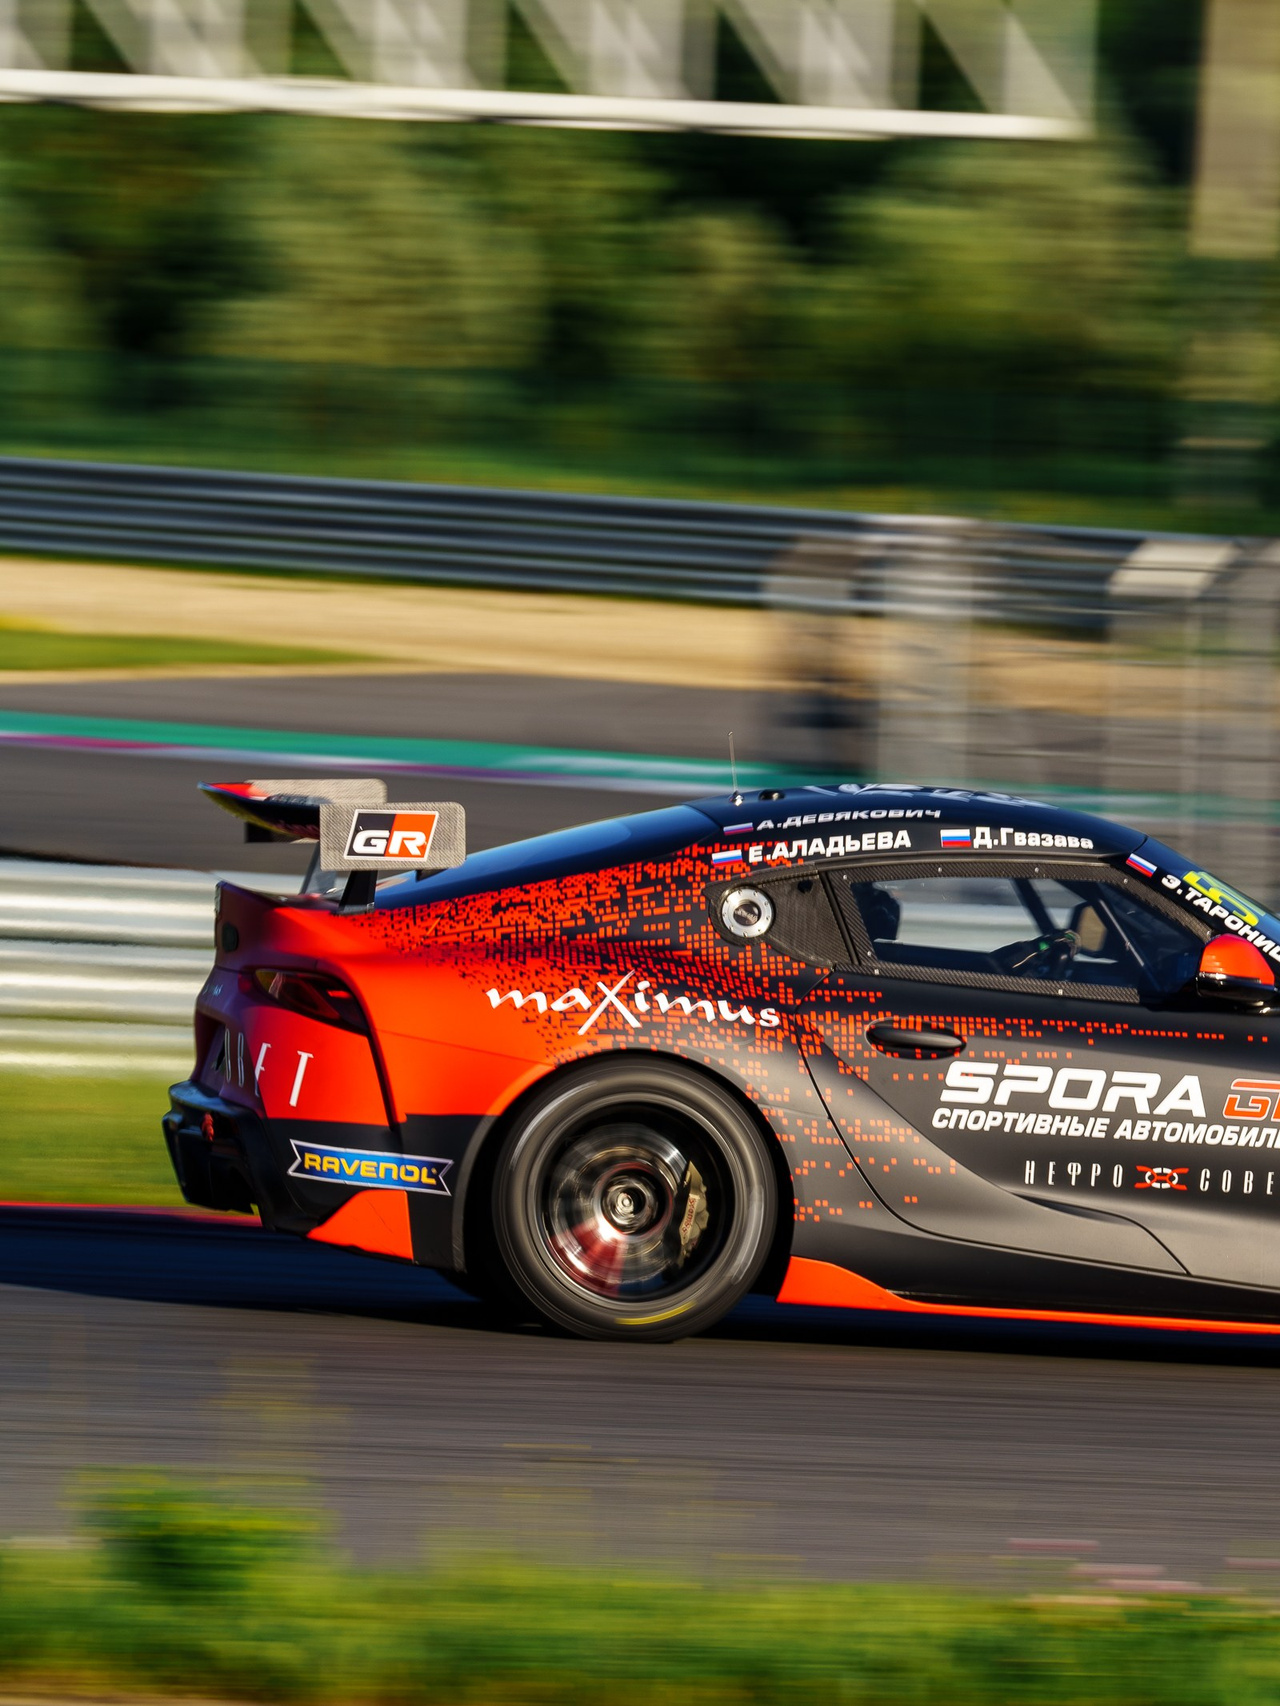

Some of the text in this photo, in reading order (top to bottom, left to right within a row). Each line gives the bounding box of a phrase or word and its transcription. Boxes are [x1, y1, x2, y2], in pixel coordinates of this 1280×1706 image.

[756, 808, 942, 831] А.ДЕВЯКОВИЧ
[352, 829, 428, 856] GR
[747, 829, 912, 864] Е.АЛАДЬЕВА
[973, 826, 1095, 850] Д.Гвазава
[939, 1060, 1207, 1119] SPORA
[931, 1107, 1111, 1139] СПОРТИВНЫЕ
[303, 1152, 438, 1186] RAVENOL
[1023, 1160, 1125, 1189] НЕФРО
